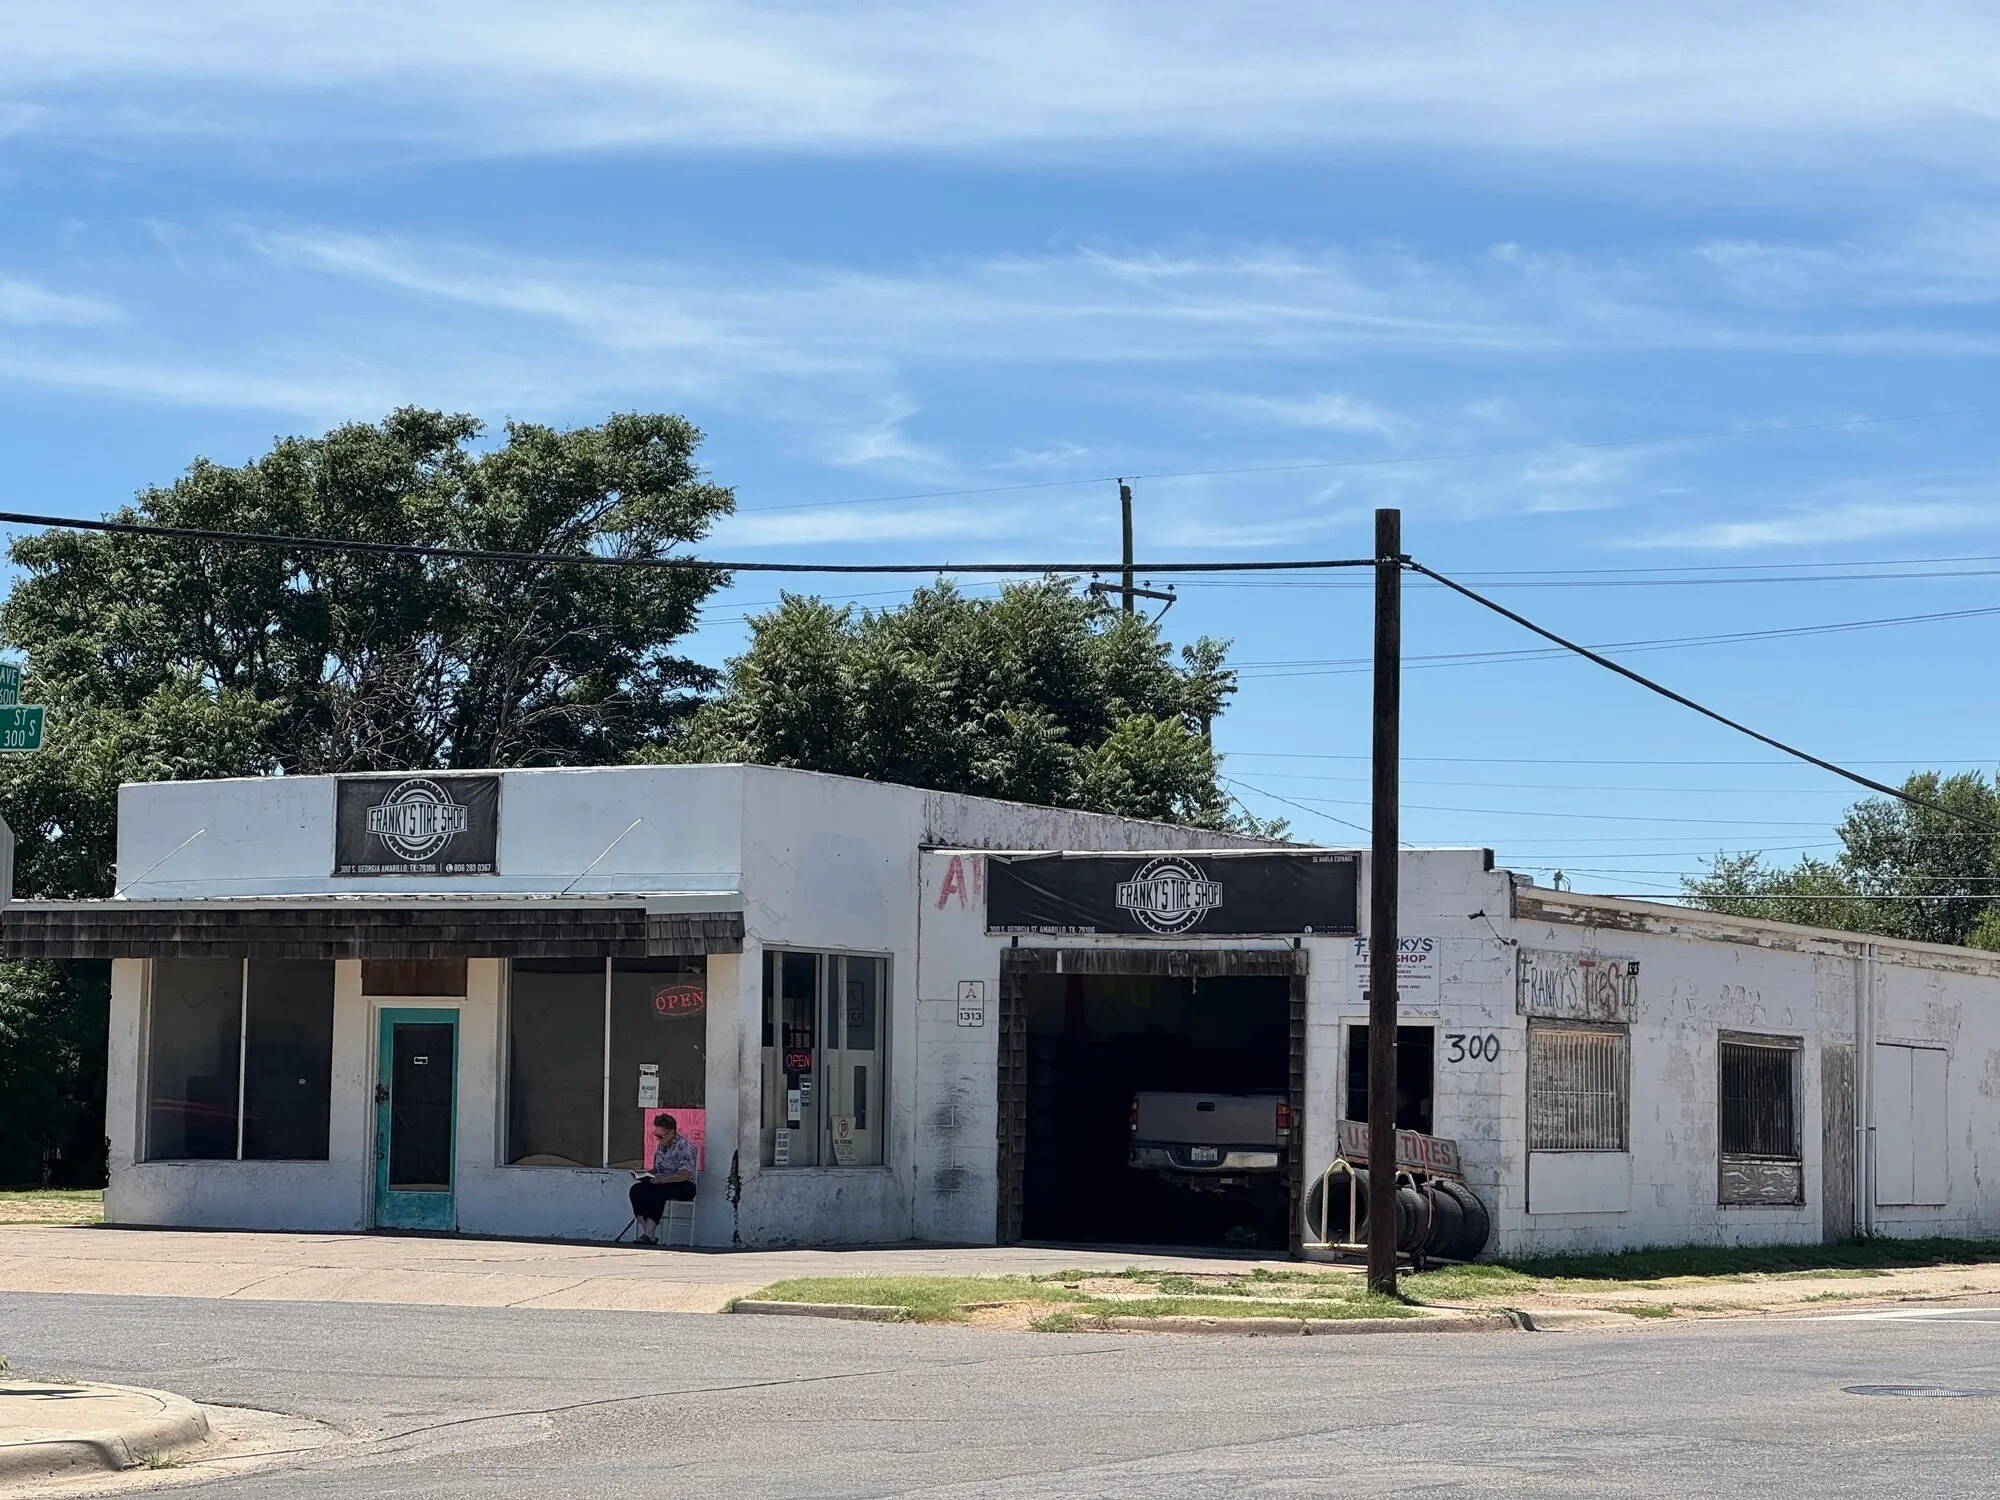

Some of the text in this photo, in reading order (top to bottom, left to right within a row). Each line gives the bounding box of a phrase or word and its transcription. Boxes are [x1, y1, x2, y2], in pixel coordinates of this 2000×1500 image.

[0, 666, 17, 686] AVE
[14, 709, 27, 726] ST
[29, 719, 36, 736] S
[4, 729, 25, 747] 300
[370, 803, 464, 835] FRANKY'S TIRE SHOP
[358, 865, 380, 873] GEORGIA
[1120, 879, 1219, 910] FRANKY'S TIRE SHOP
[1354, 937, 1434, 956] FKY'S
[655, 992, 704, 1011] OPEN
[960, 1012, 982, 1021] 1313
[1445, 1033, 1500, 1063] 300
[786, 1054, 811, 1068] OPEN
[1400, 1135, 1452, 1165] TIRES
